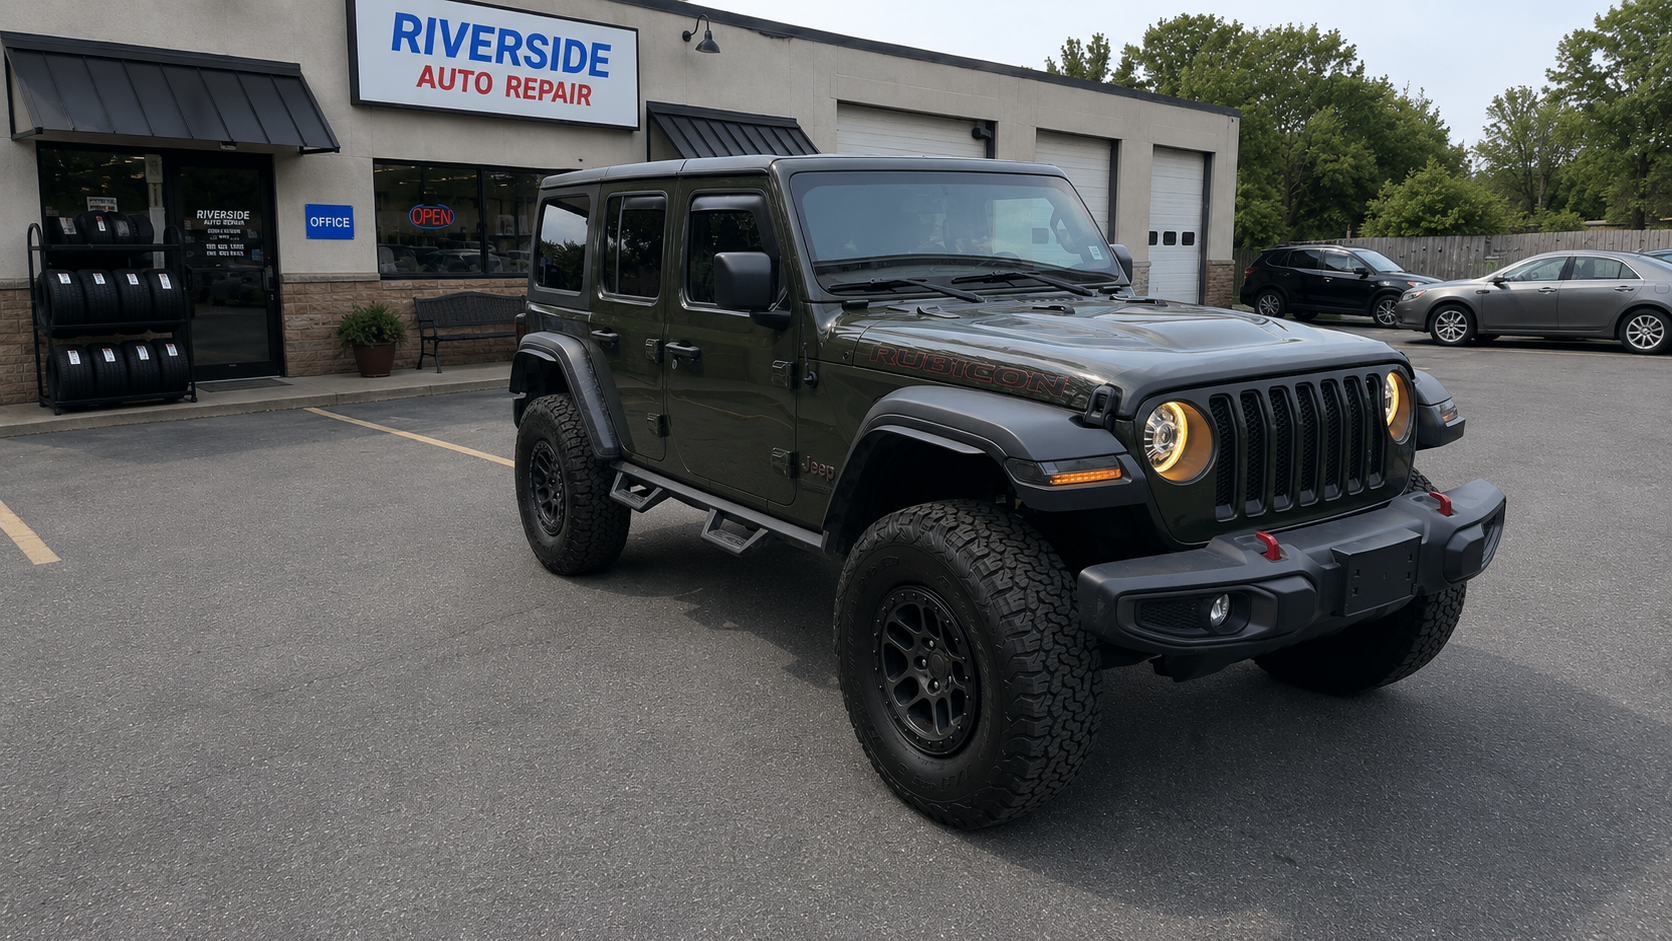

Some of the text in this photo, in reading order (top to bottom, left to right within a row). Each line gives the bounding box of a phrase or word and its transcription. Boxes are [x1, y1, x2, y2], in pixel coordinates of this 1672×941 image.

[391, 12, 611, 78] RIVERSIDE
[416, 65, 592, 106] AUTO REPAIR
[196, 210, 250, 220] RIVERSIDE
[310, 217, 350, 228] OFFICE
[412, 208, 451, 225] OPEN
[869, 344, 1069, 398] RUBICON
[801, 455, 835, 482] Jeep
